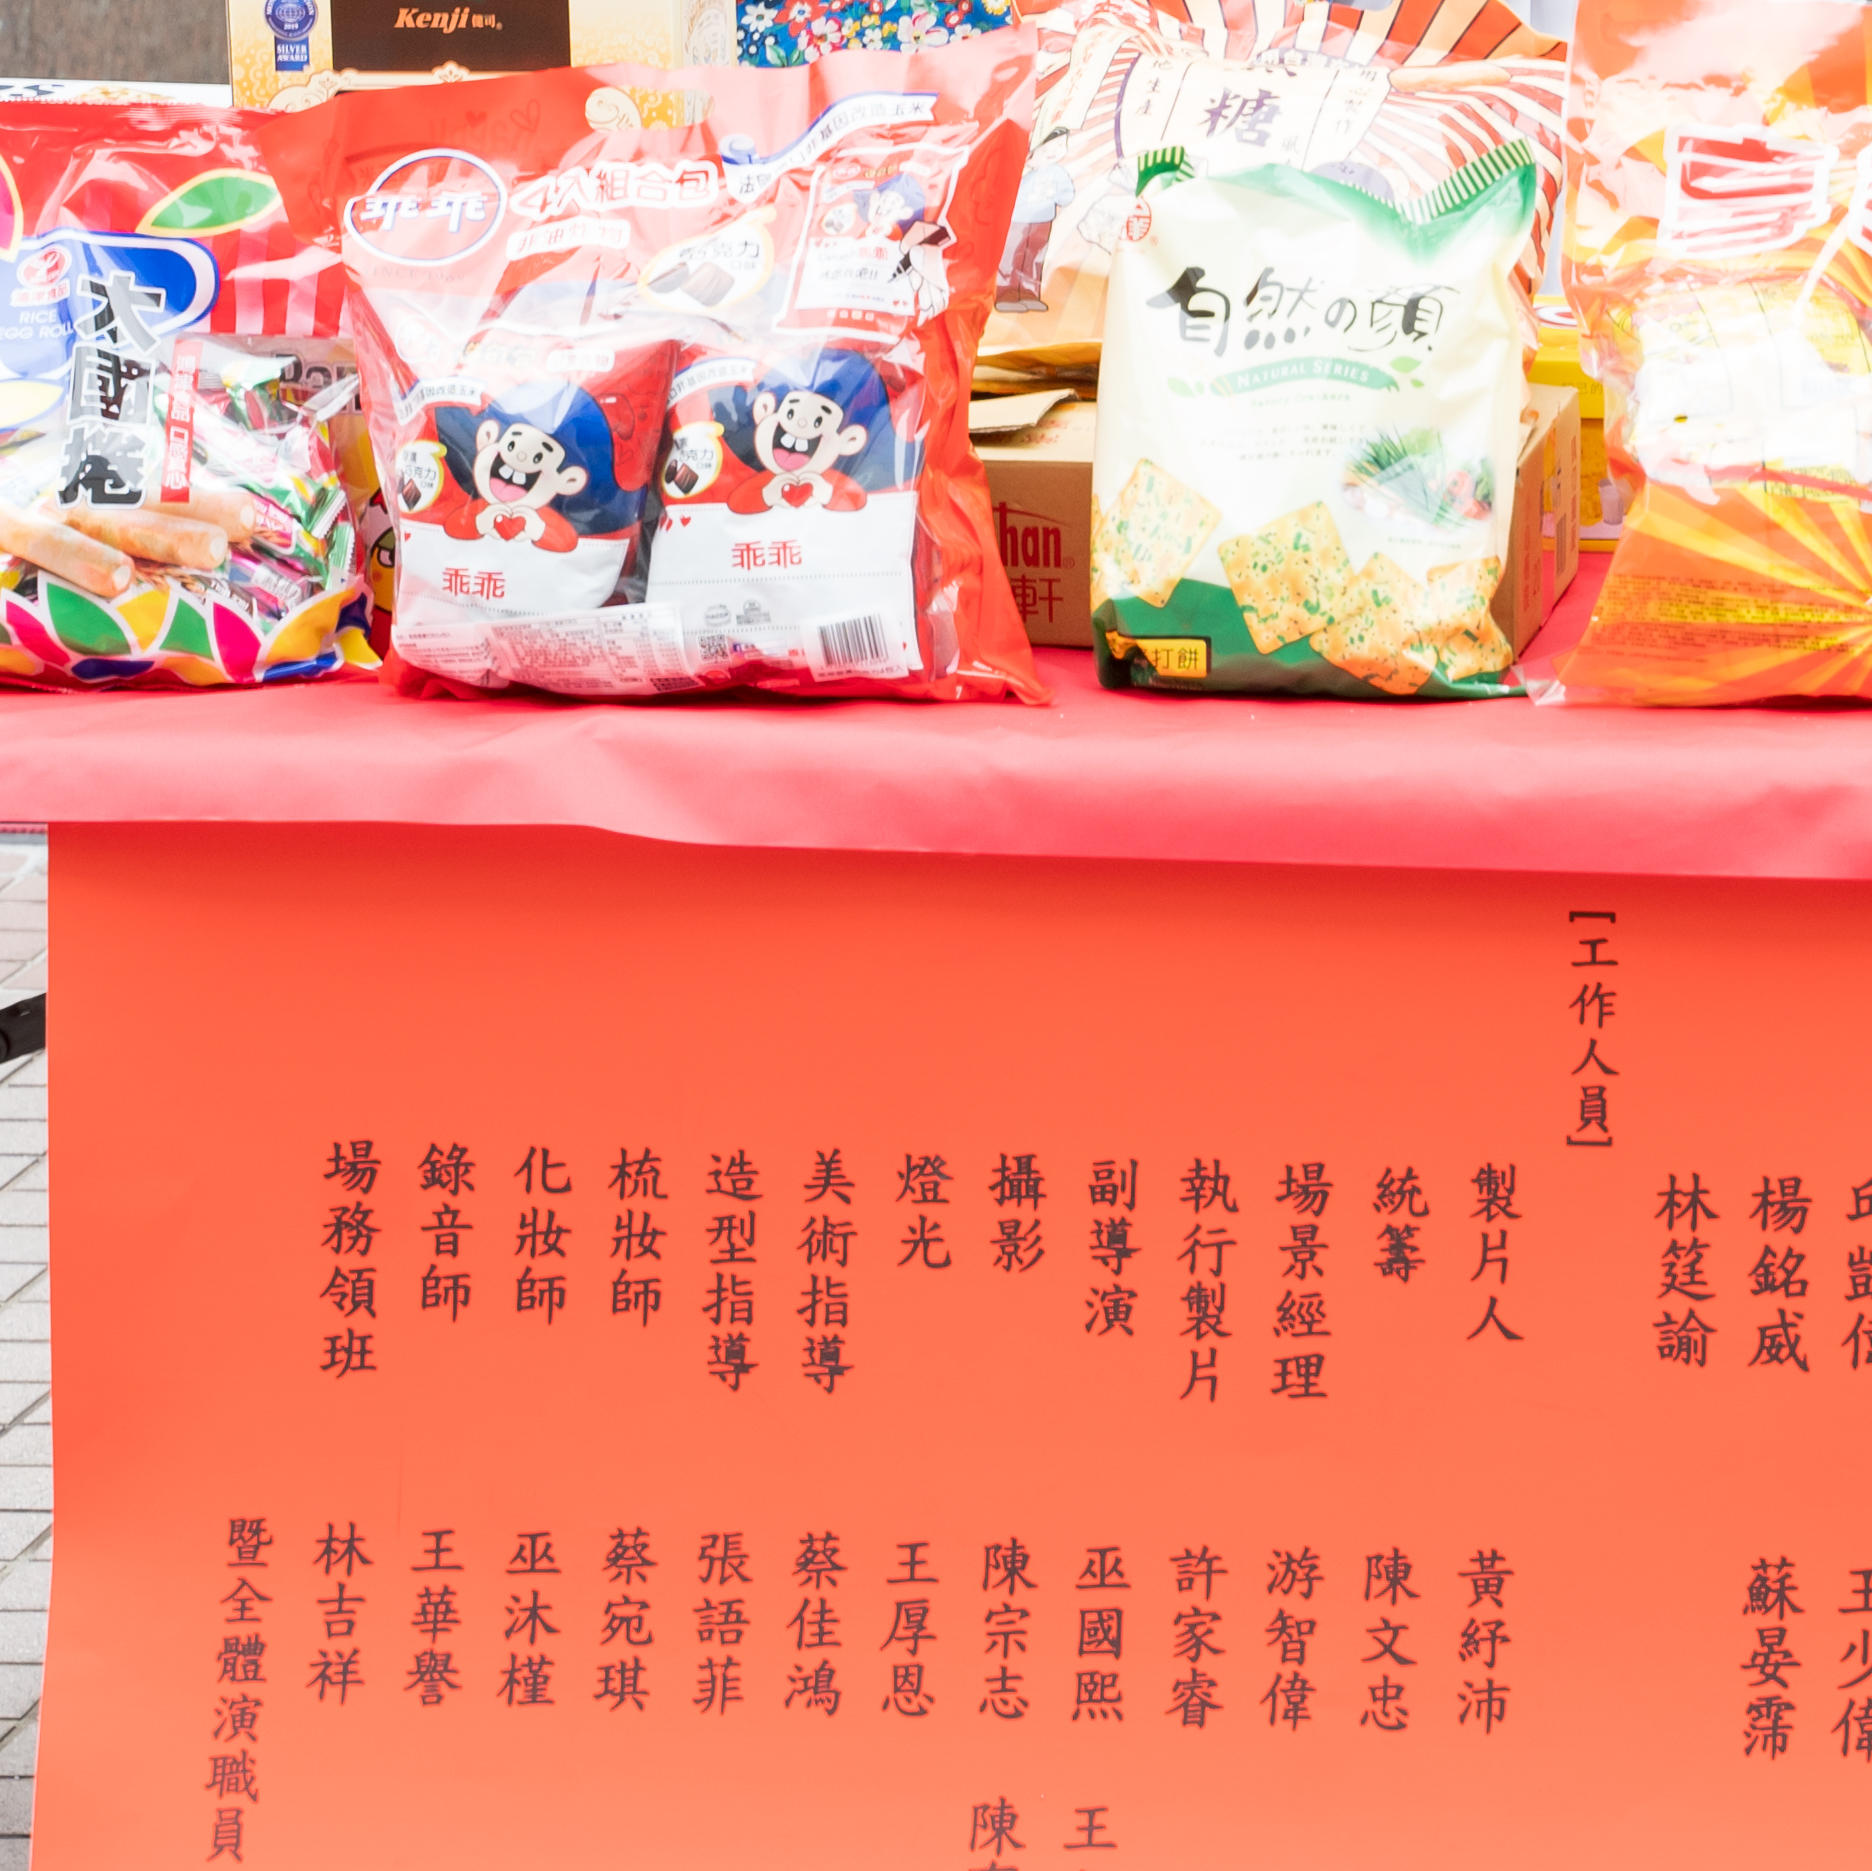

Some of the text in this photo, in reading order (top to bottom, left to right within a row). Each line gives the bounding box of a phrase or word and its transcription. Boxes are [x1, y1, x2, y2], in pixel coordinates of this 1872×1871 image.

[277, 43, 308, 55] SILVER
[394, 7, 471, 34] Kenji
[360, 194, 489, 234] 乖乖
[18, 310, 59, 325] RICE
[38, 322, 75, 339] ROLL
[442, 567, 506, 601] 乖乖
[732, 540, 803, 571] 乖乖
[319, 1139, 382, 1379] 場務領班
[417, 1142, 476, 1323] 錄音師
[513, 1146, 572, 1326] 化妝師
[607, 1147, 669, 1328] 梳妝師
[701, 1149, 763, 1392] 造型指導
[796, 1148, 858, 1395] 美術指導
[895, 1153, 954, 1270] 燈光
[987, 1153, 1047, 1273] 攝影
[1084, 1158, 1142, 1337] 副導演
[1177, 1157, 1239, 1403] 執行製片
[1270, 1161, 1334, 1399] 場景經理
[1372, 1166, 1430, 1284] 統籌
[1467, 1162, 1524, 1341] 製片人
[1748, 1175, 1813, 1373] 楊銘威
[206, 1517, 273, 1862] 暨全體演職員
[307, 1521, 373, 1704] 林吉祥
[405, 1529, 464, 1706] 王華譽
[497, 1531, 561, 1706] 巫沐槿
[593, 1526, 657, 1711] 蔡宛琪
[693, 1532, 752, 1714] 張語菲
[784, 1531, 847, 1717] 蔡佳鴻
[880, 1542, 939, 1717] 王厚恩
[979, 1537, 1038, 1720] 陳宗志
[1071, 1546, 1131, 1721] 巫國熙
[1166, 1545, 1228, 1729] 許家睿
[1261, 1546, 1324, 1731] 游智偉
[1360, 1547, 1420, 1731] 陳文忠
[1457, 1548, 1514, 1734] 黃紓沛
[1740, 1556, 1805, 1760] 蘇晏霈
[967, 1796, 1026, 1871] 陳
